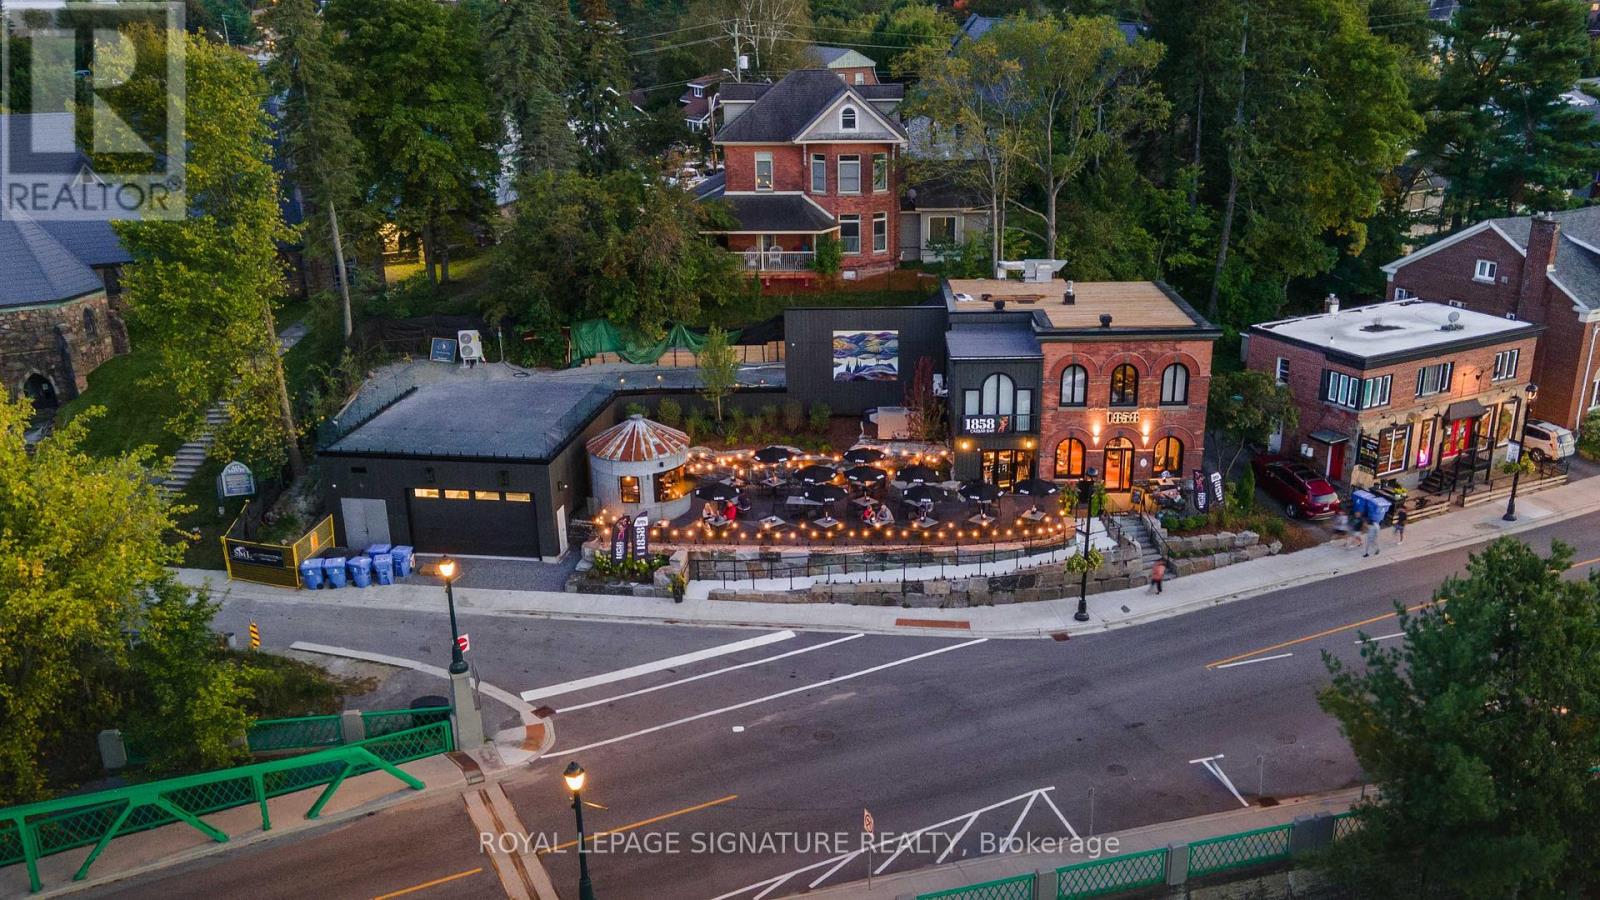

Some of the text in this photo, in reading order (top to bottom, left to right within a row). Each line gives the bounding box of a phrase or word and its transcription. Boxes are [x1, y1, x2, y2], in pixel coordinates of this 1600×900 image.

[965, 418, 995, 430] 1858
[1107, 411, 1140, 425] 1858
[636, 527, 645, 550] 1858
